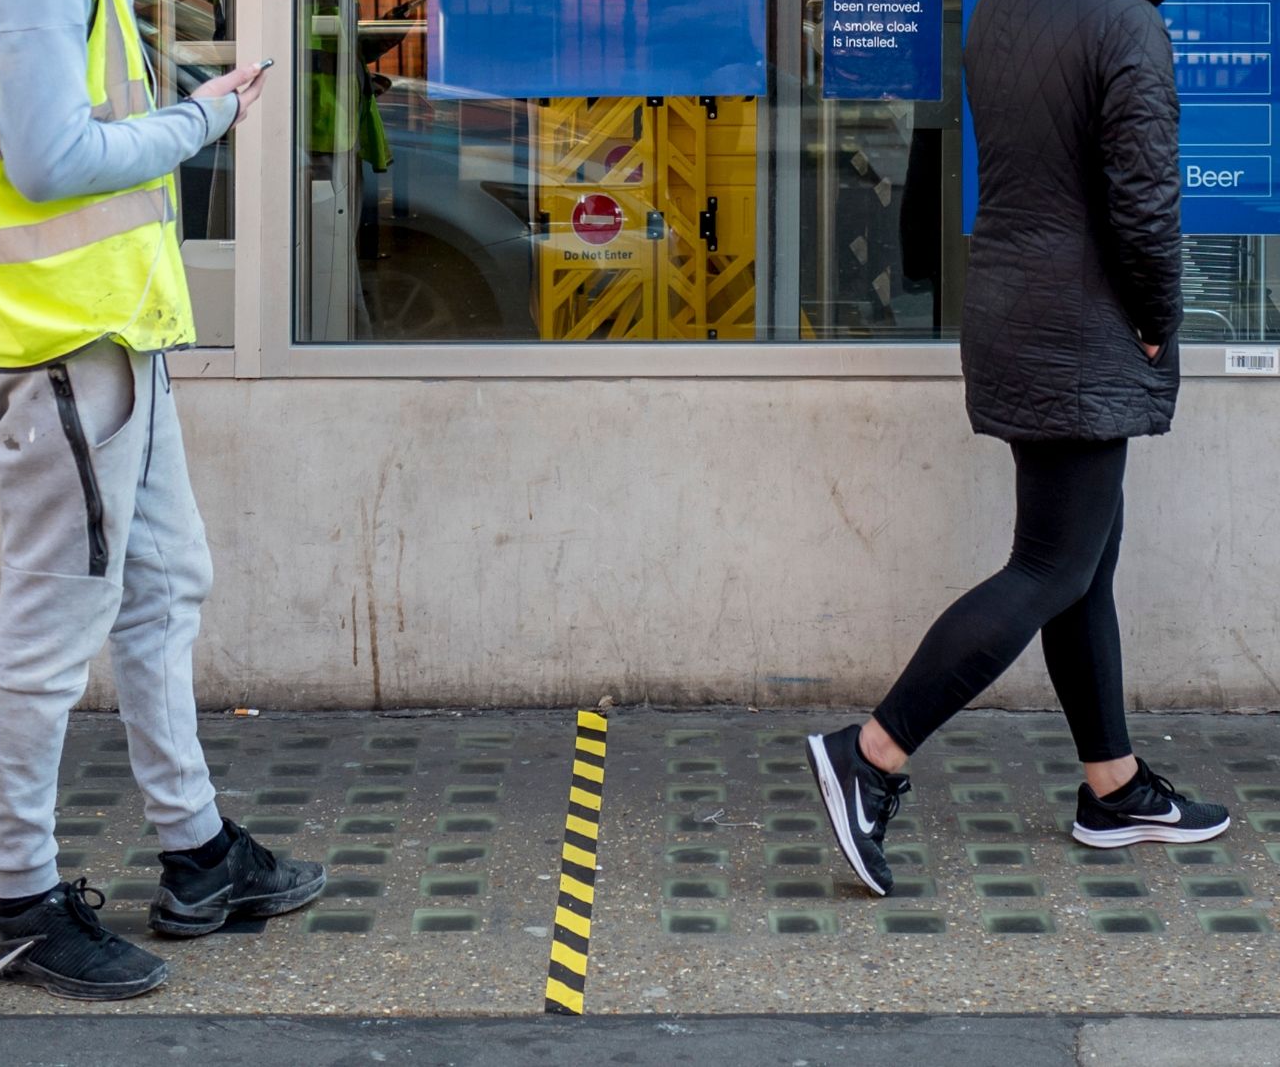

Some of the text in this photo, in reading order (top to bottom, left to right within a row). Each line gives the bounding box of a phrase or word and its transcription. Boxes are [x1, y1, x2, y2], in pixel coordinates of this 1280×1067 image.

[833, 0, 923, 13] been removed.
[833, 20, 918, 32] A smoke cloak
[833, 36, 898, 48] is installed.
[1187, 166, 1244, 187] Beer
[564, 250, 632, 260] Do Not Enter
